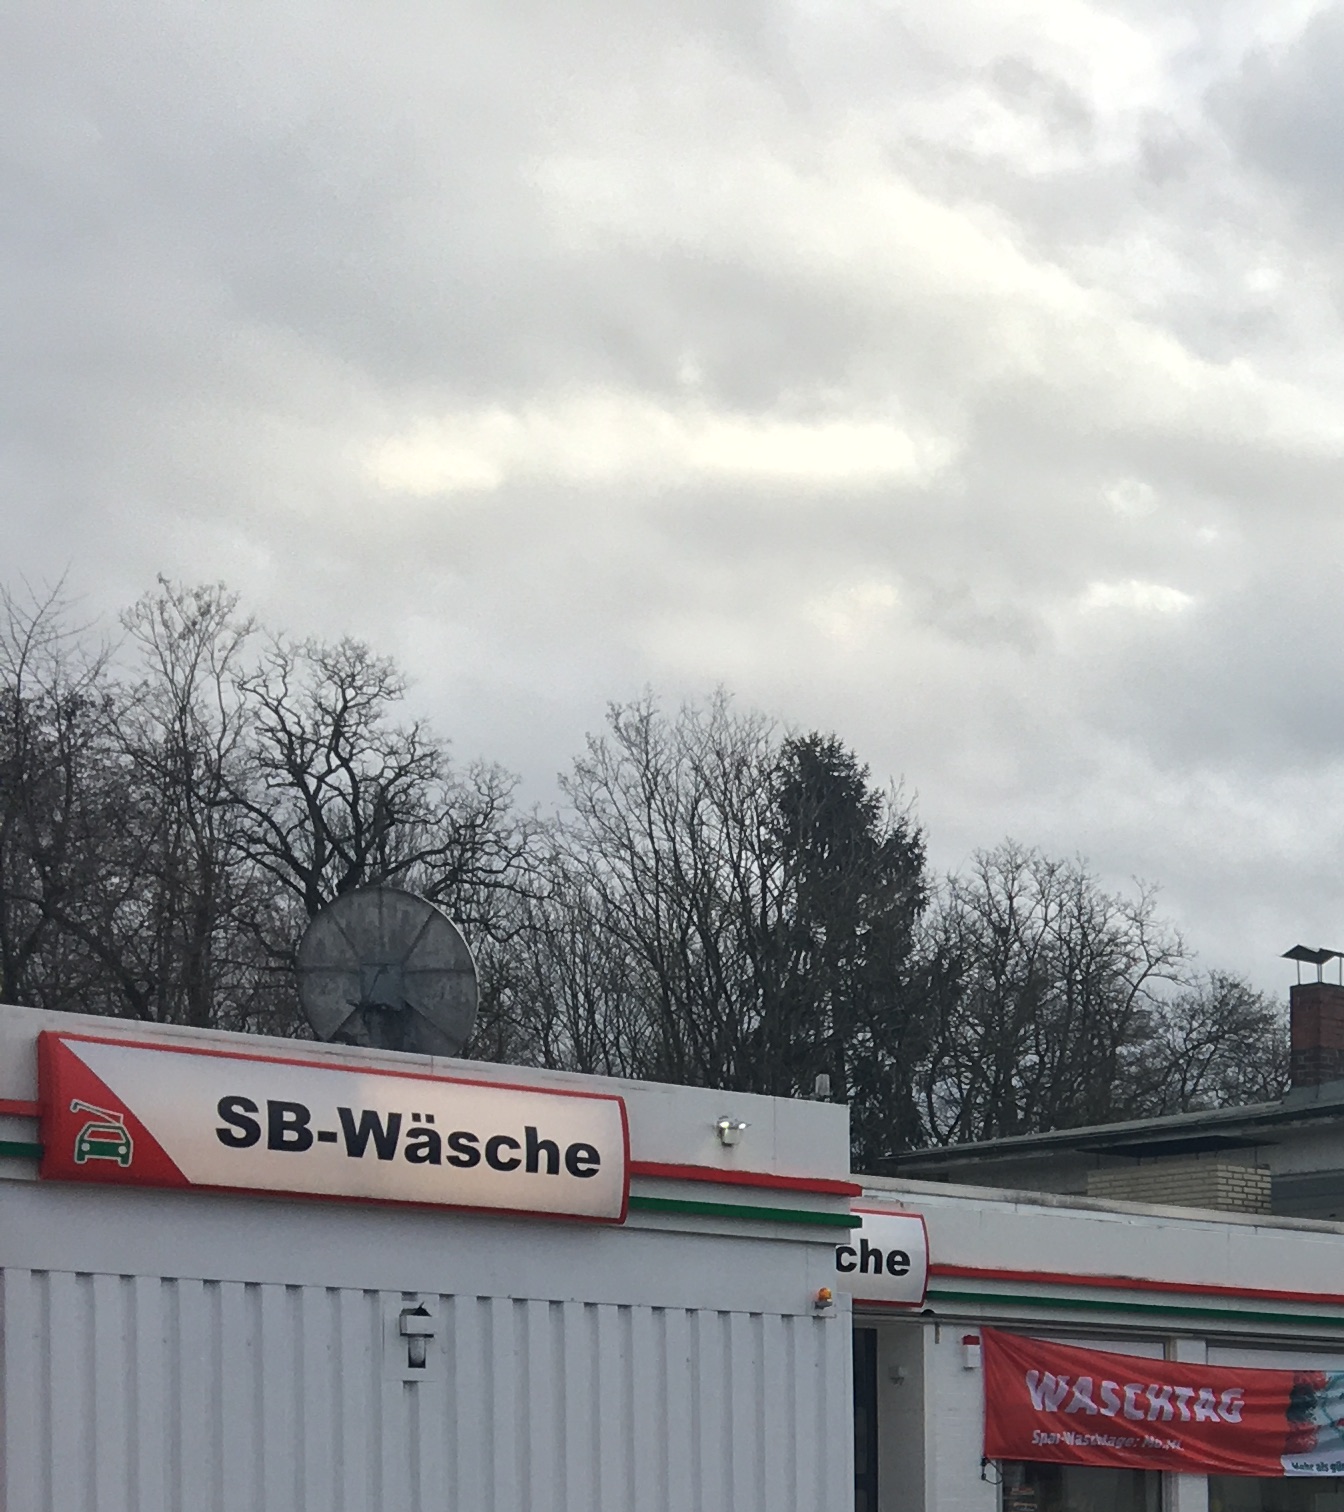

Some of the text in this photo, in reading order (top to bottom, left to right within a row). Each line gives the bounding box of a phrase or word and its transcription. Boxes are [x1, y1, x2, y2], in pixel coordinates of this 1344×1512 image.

[215, 1095, 601, 1178] SB-Wäsche
[835, 1238, 911, 1276] che
[1025, 1369, 1245, 1423] WASCHTAG
[1316, 1461, 1329, 1472] als
